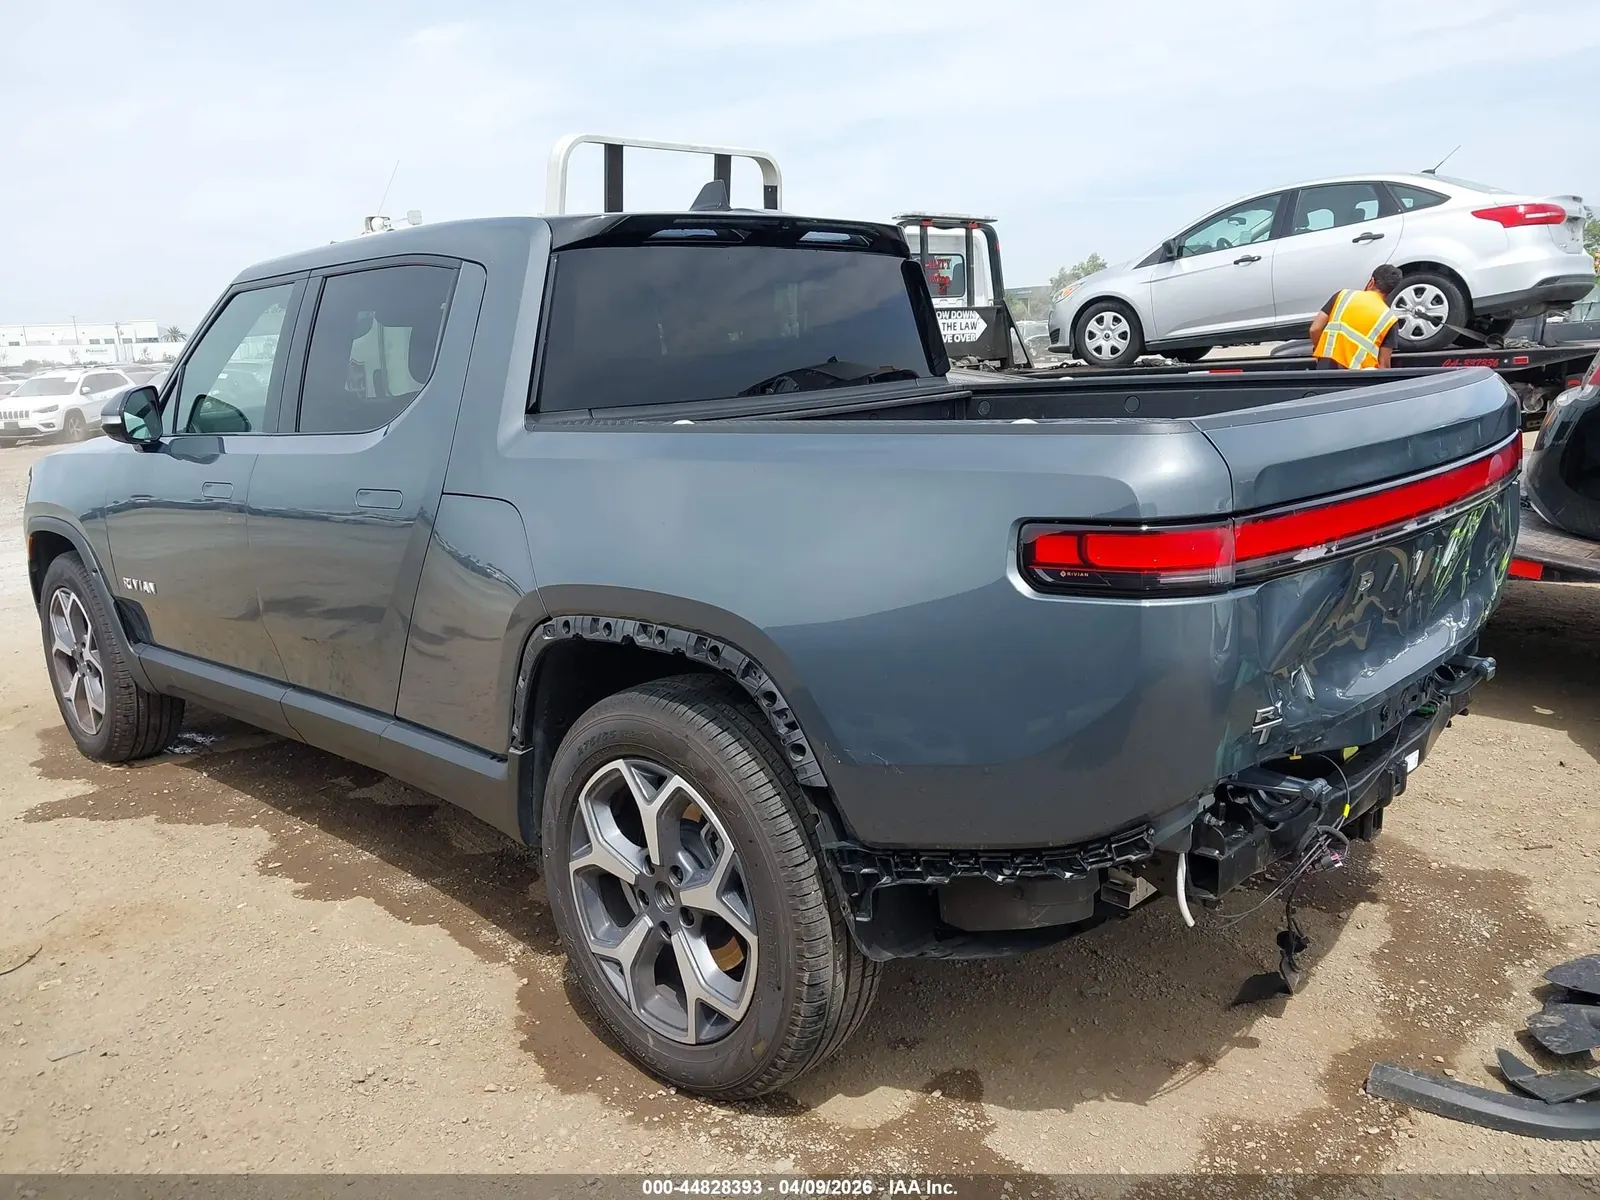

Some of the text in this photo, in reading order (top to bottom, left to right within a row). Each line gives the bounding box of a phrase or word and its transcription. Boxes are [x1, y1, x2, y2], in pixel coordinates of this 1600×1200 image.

[936, 310, 976, 320] OW DOWN
[941, 321, 978, 331] THE LAW
[943, 333, 977, 343] VE OVER
